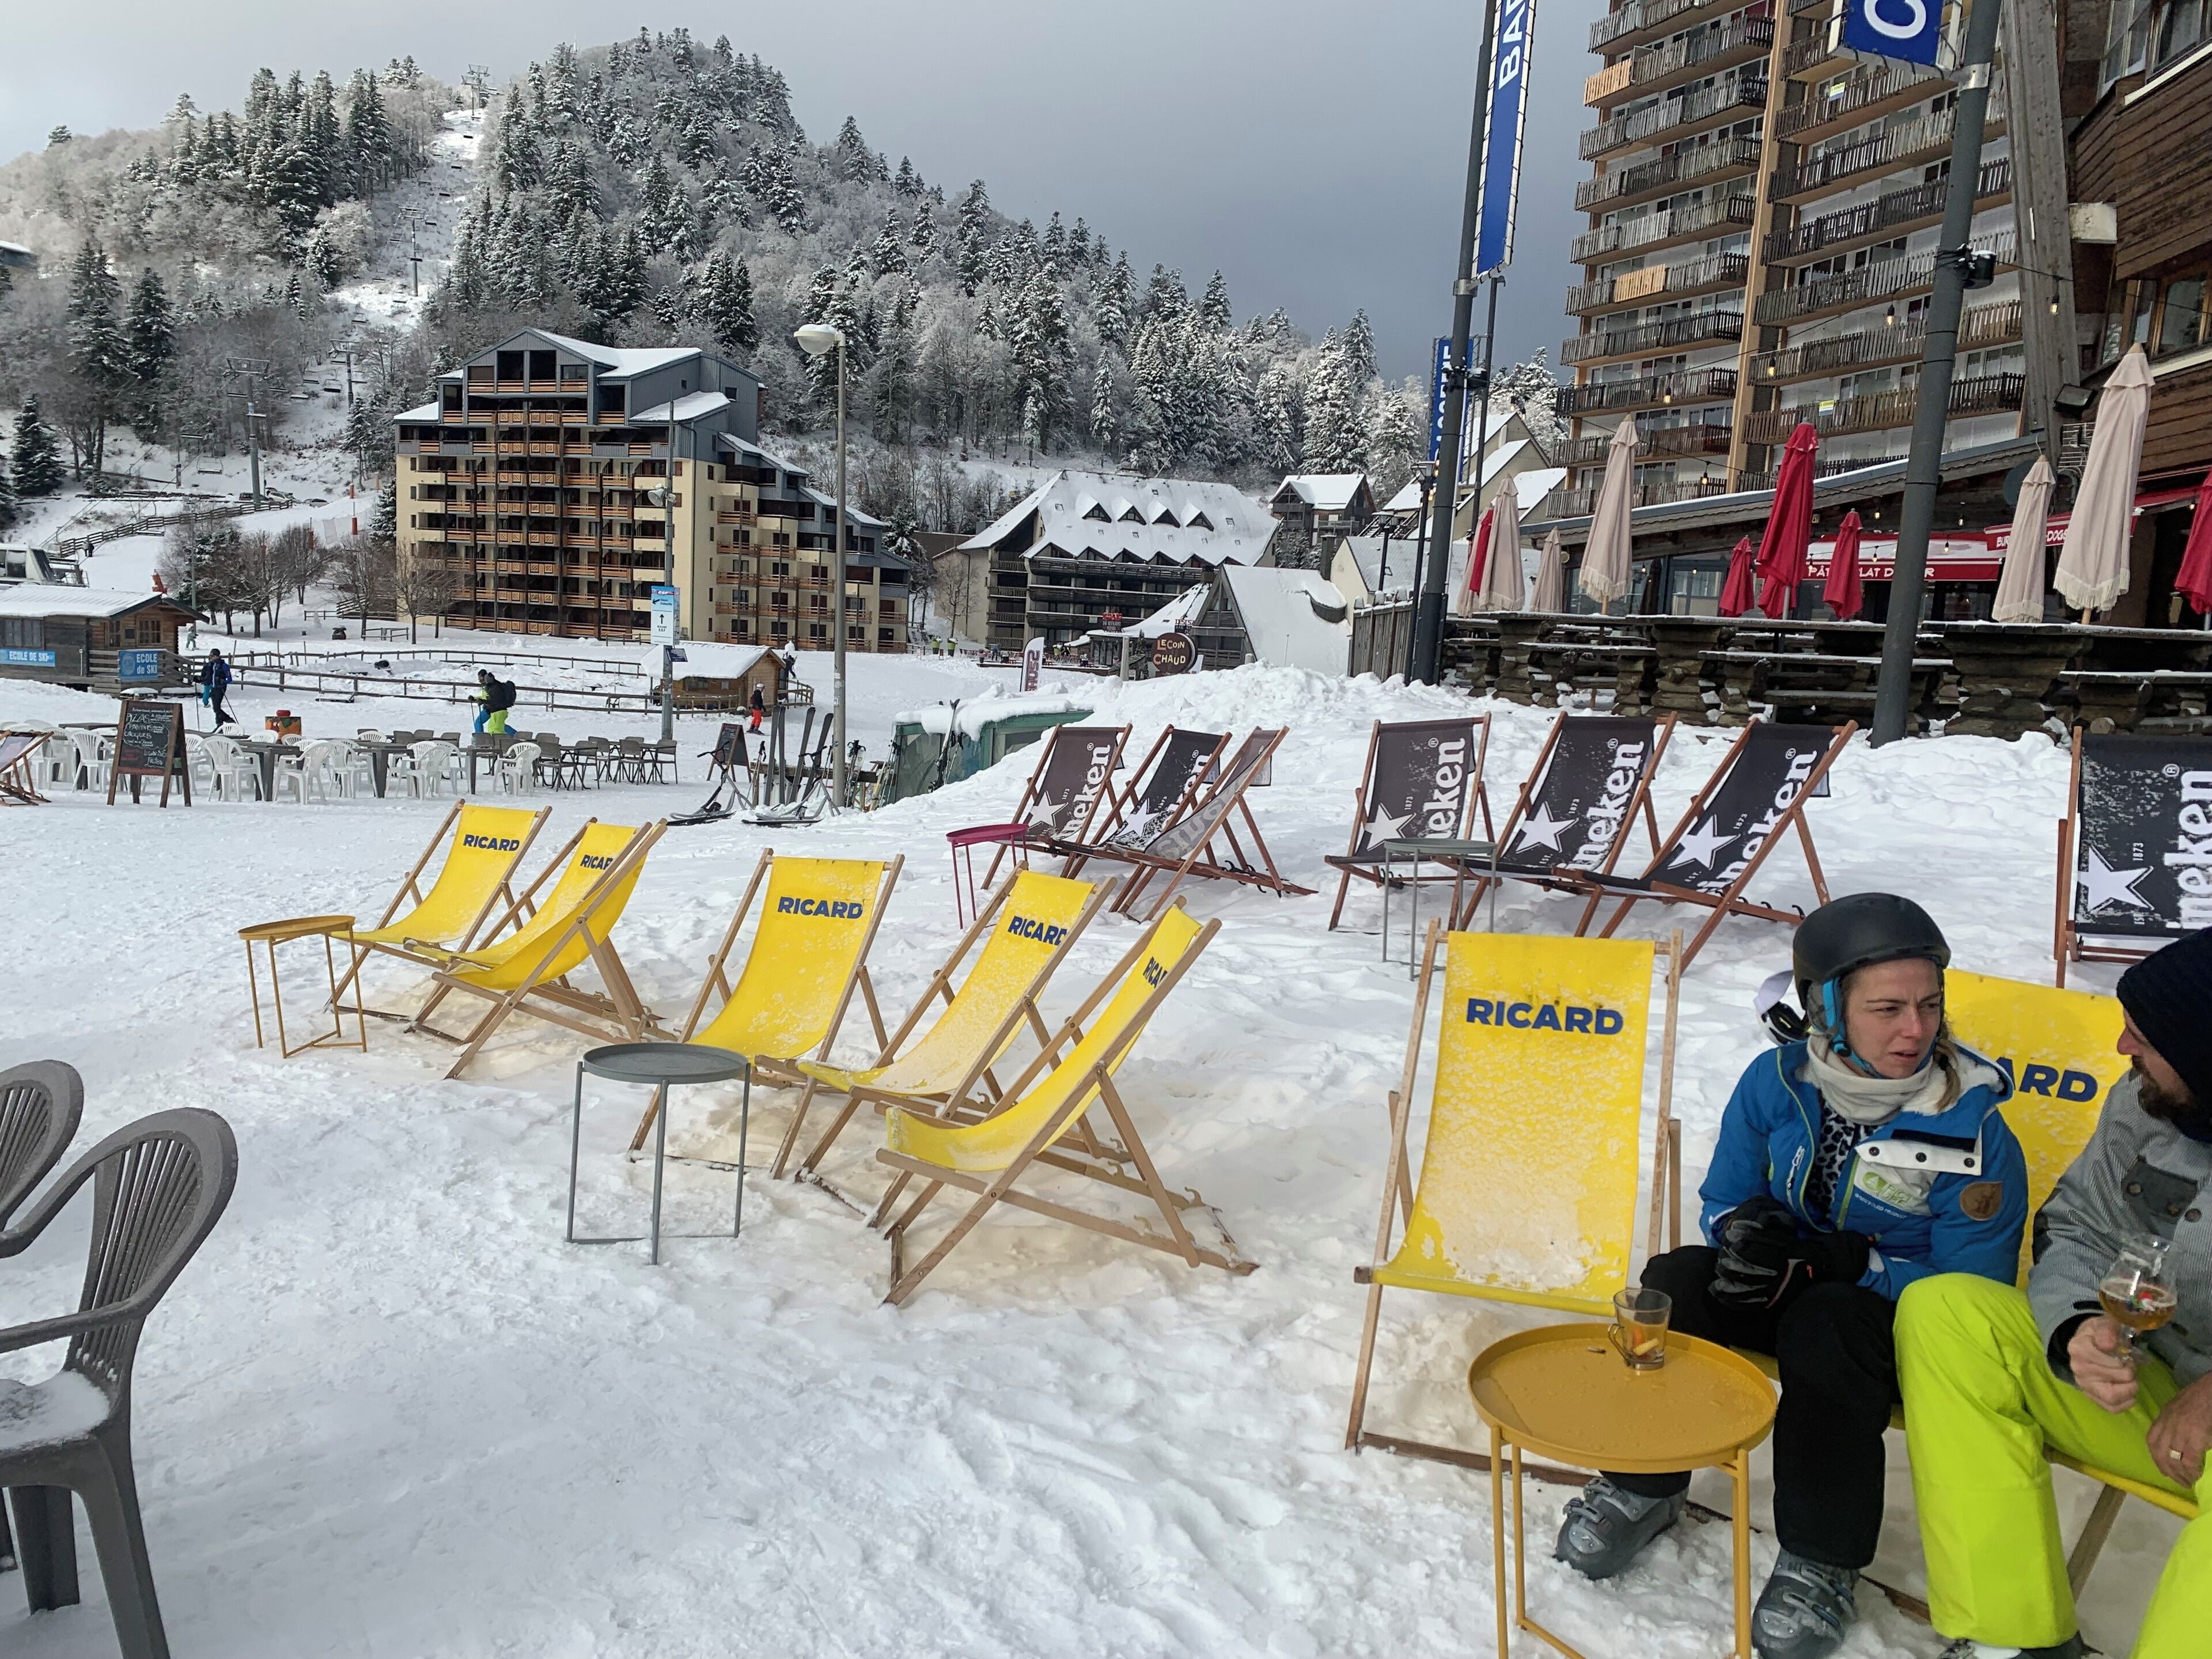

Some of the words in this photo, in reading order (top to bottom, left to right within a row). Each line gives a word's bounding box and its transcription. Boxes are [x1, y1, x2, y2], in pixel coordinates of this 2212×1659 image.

[9, 651, 28, 661] ECOLE
[29, 652, 37, 661] DE
[136, 653, 157, 663] ECOLE
[1153, 654, 1186, 665] CHAUD
[137, 665, 145, 675] de
[146, 664, 157, 675] SKI
[1404, 796, 1414, 810] 1873
[1568, 798, 1580, 814] 1873
[1733, 813, 1748, 830] 1873
[463, 834, 520, 851] RICARD
[2133, 842, 2145, 862] 1873
[579, 854, 613, 870] RICAR
[778, 896, 863, 919] RICARD
[1466, 998, 1624, 1035] RICARD
